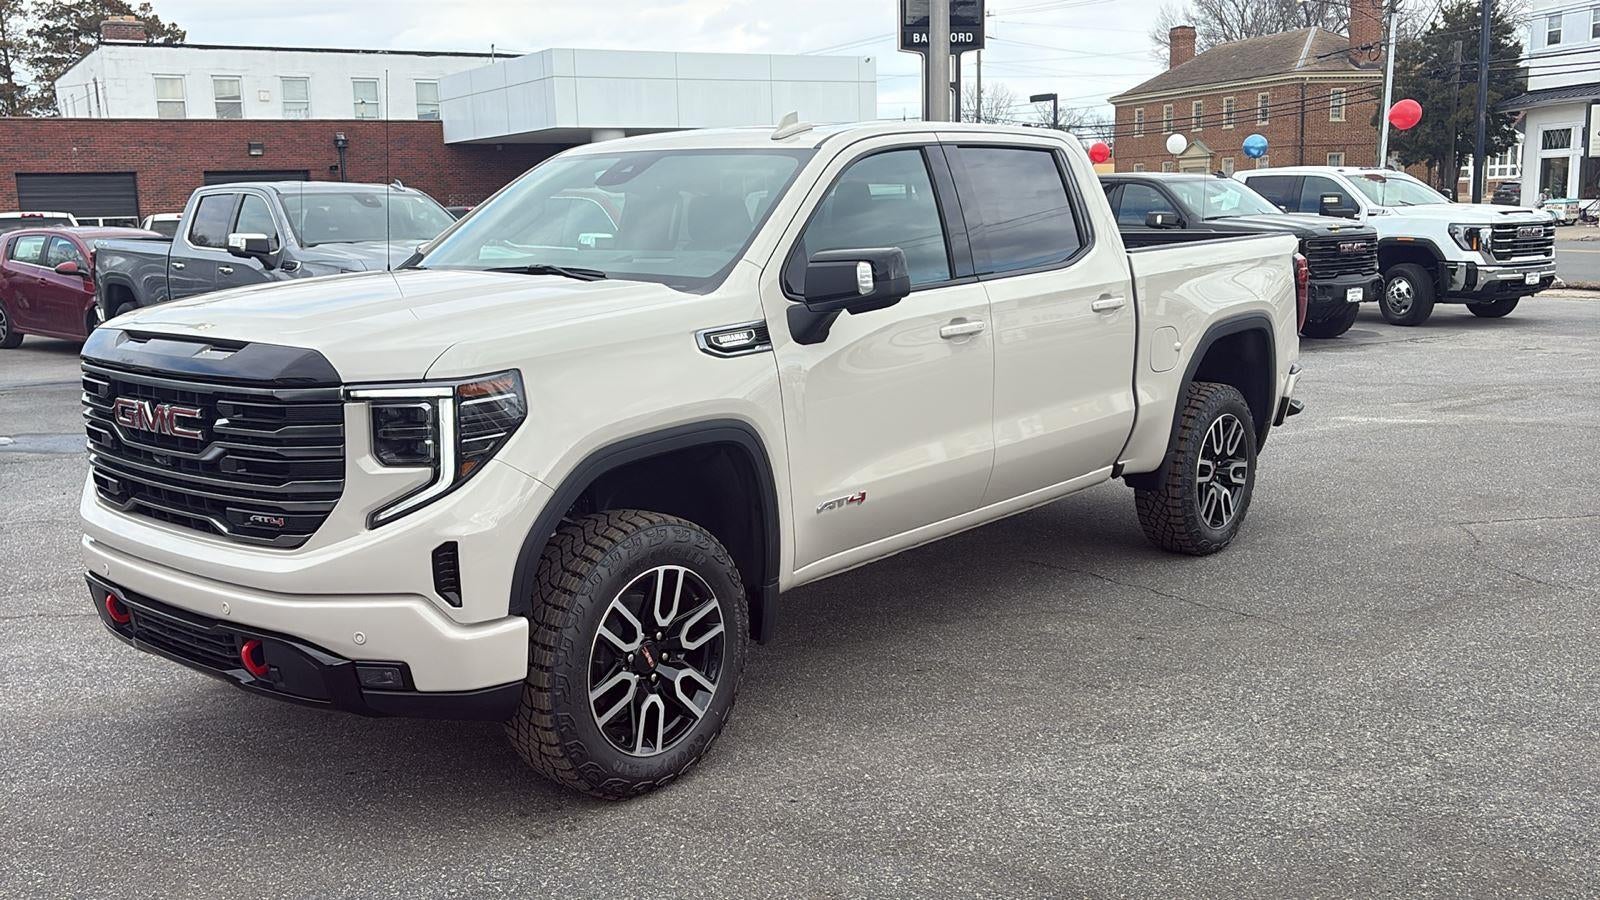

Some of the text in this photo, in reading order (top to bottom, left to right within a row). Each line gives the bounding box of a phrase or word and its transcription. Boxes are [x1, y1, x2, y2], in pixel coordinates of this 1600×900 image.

[718, 332, 749, 343] DURAMAX
[114, 397, 204, 440] GMC
[816, 490, 867, 514] AT4
